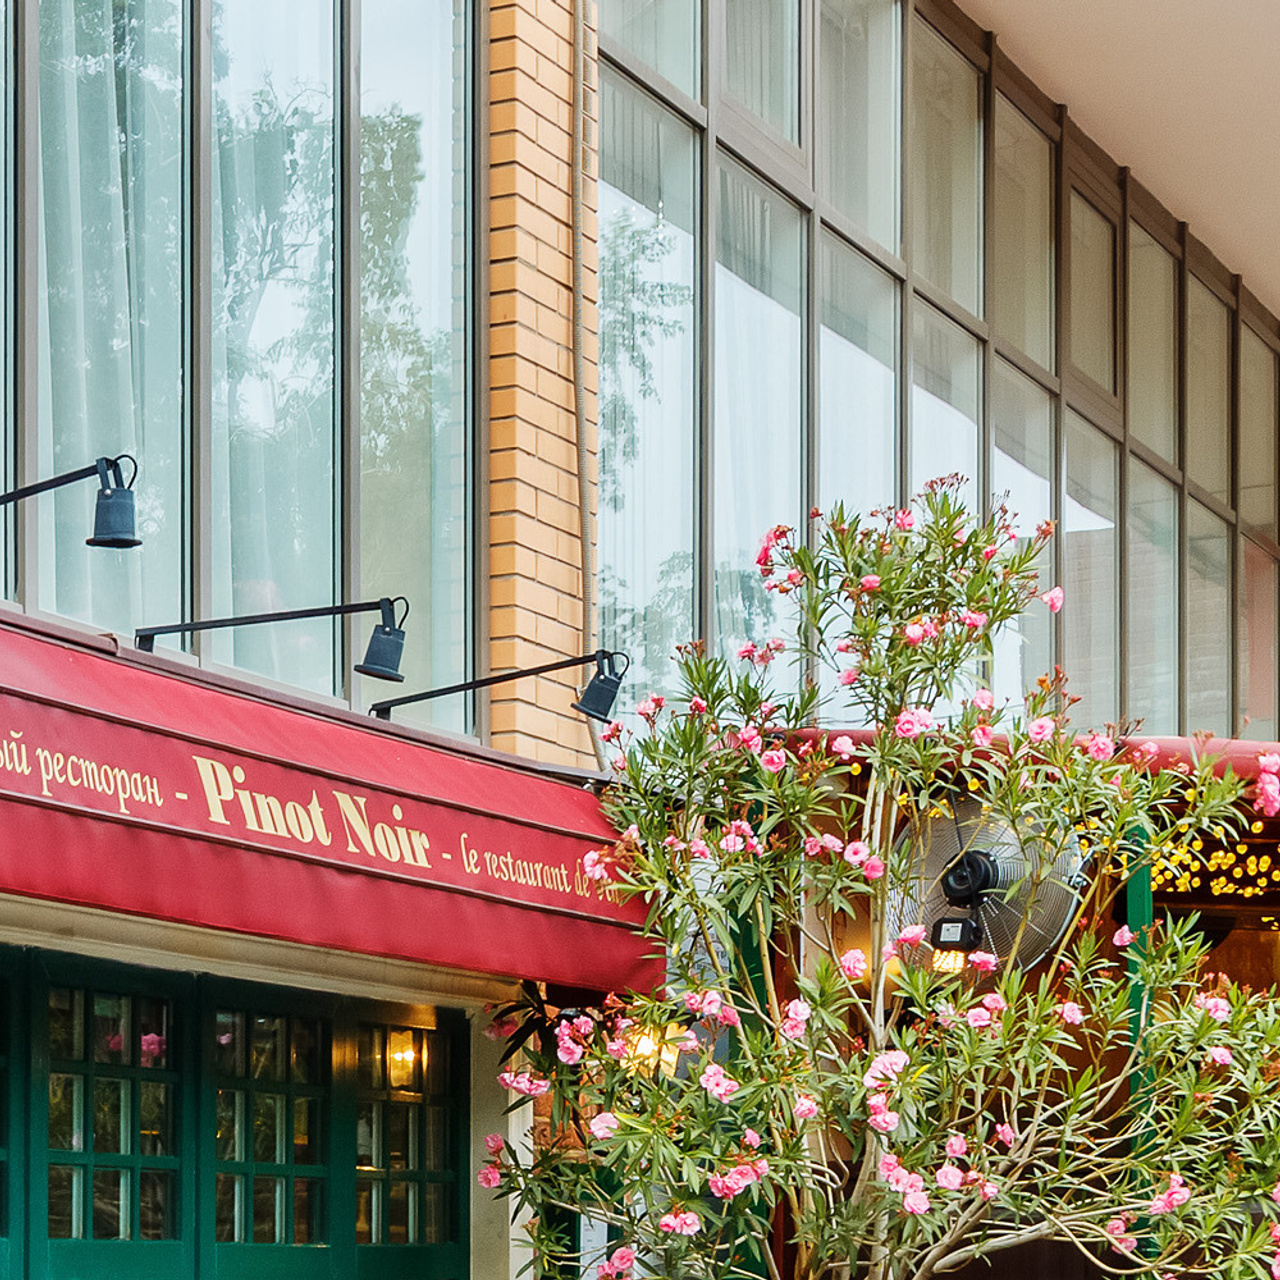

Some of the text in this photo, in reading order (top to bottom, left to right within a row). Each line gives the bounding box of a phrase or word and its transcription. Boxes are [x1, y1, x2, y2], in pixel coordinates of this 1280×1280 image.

[36, 747, 164, 815] ресторан
[192, 754, 332, 847] Pinot
[332, 790, 432, 869] Noir
[460, 832, 482, 875] le
[483, 850, 573, 894] restaurant
[574, 857, 592, 899] de
